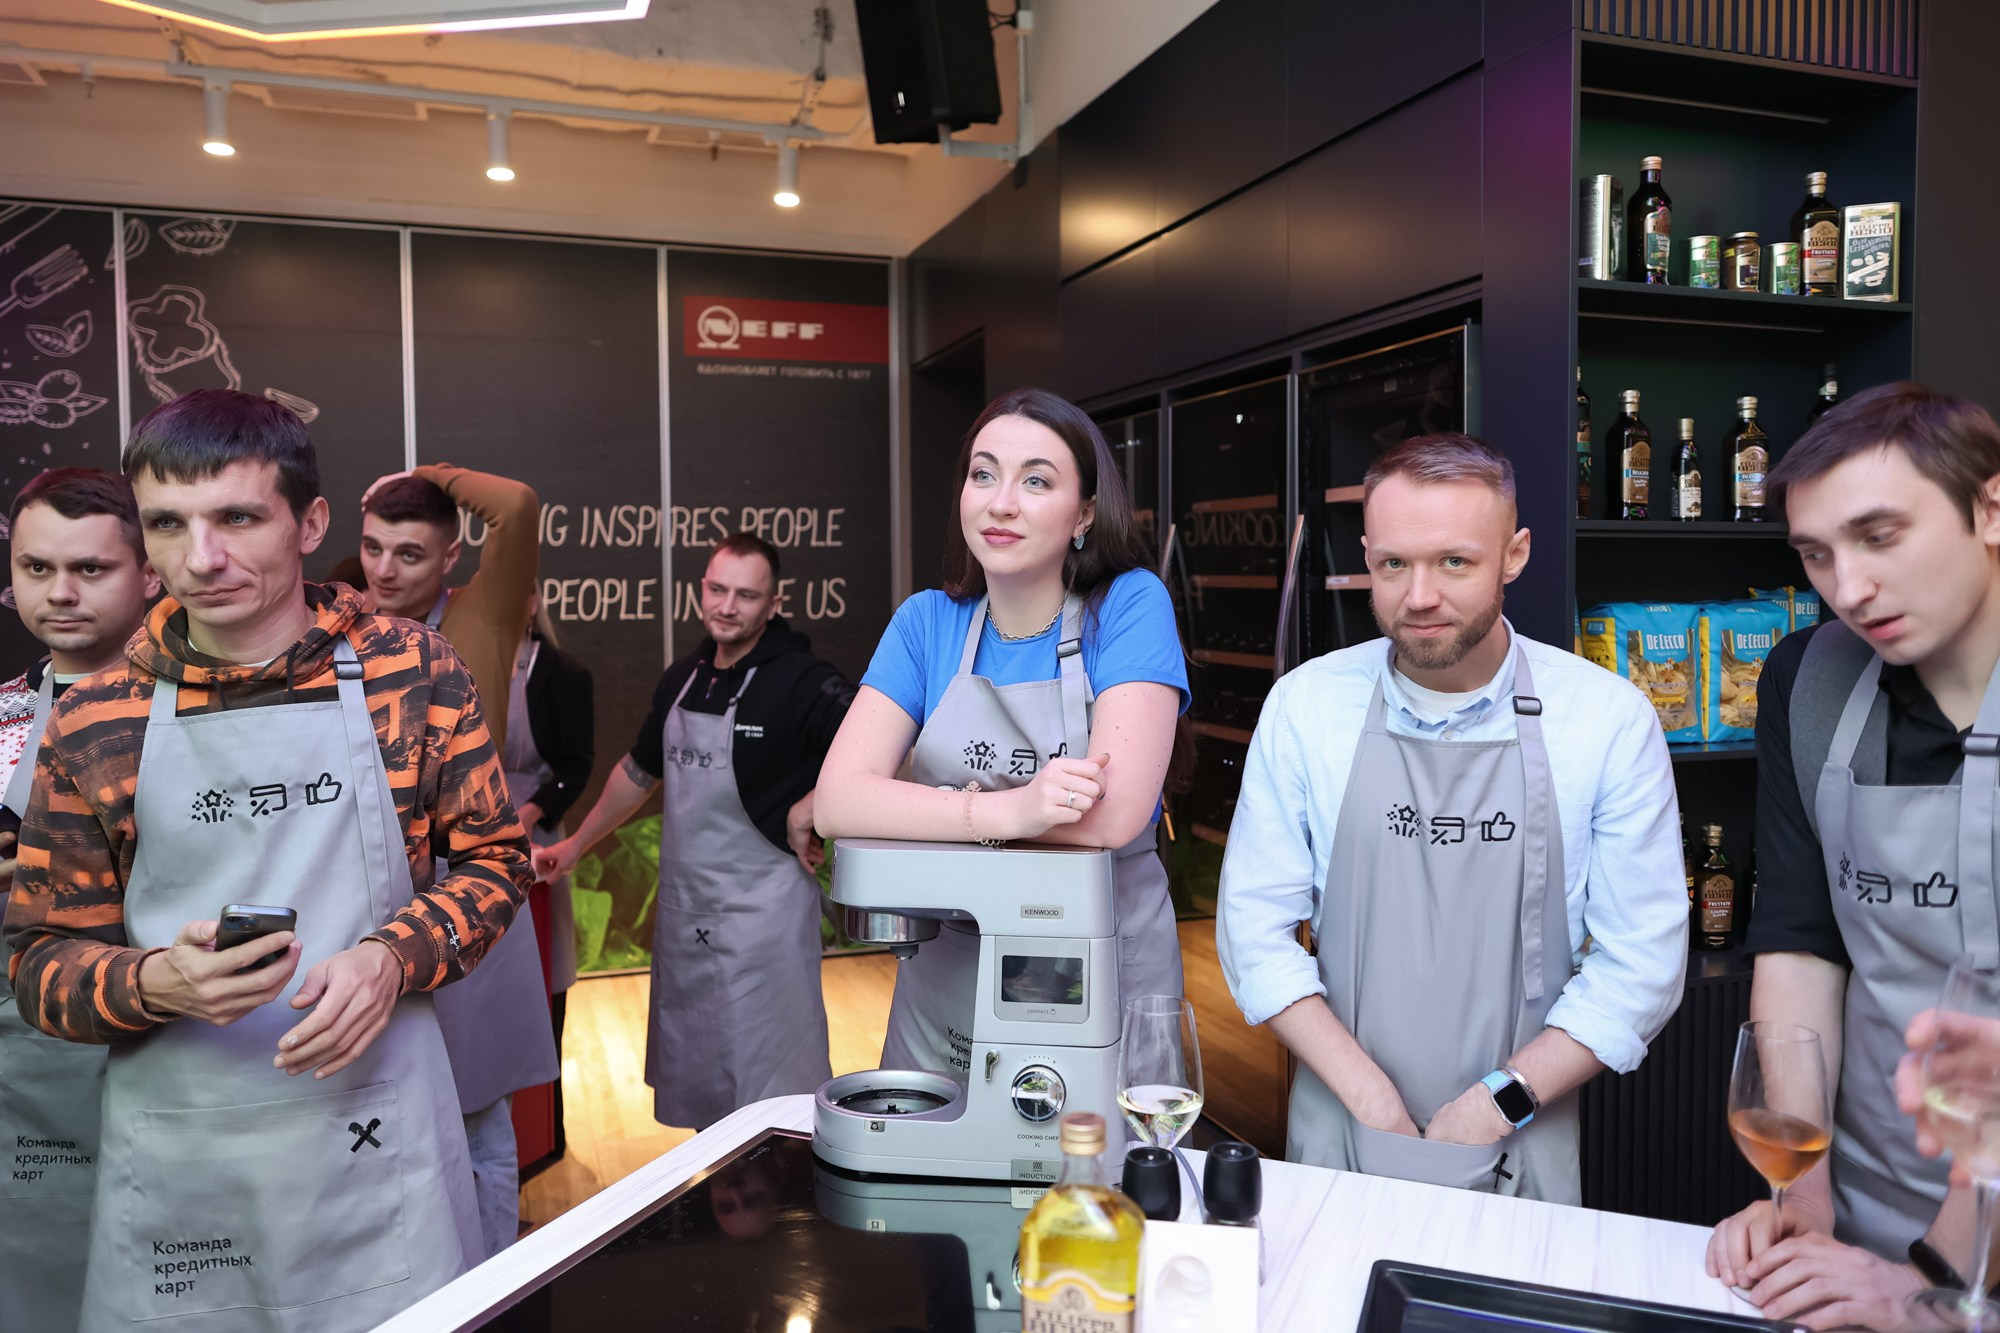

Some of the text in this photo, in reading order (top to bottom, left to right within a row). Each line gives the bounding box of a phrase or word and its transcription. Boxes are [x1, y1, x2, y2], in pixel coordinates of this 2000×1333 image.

[1850, 227, 1892, 236] BERIO
[699, 312, 824, 344] NEFF
[580, 503, 729, 548] INSPIRES
[740, 507, 845, 547] PEOPLE
[543, 577, 657, 622] PEOPLE
[806, 577, 847, 620] US
[1659, 633, 1685, 650] CECCO
[1748, 633, 1770, 649] CECCO
[949, 1056, 970, 1072] кар
[17, 1135, 76, 1150] Команда
[15, 1154, 91, 1168] кредитных
[13, 1170, 44, 1184] карт
[153, 1238, 232, 1255] Команда
[154, 1255, 252, 1279] кредитных
[155, 1280, 196, 1298] карт
